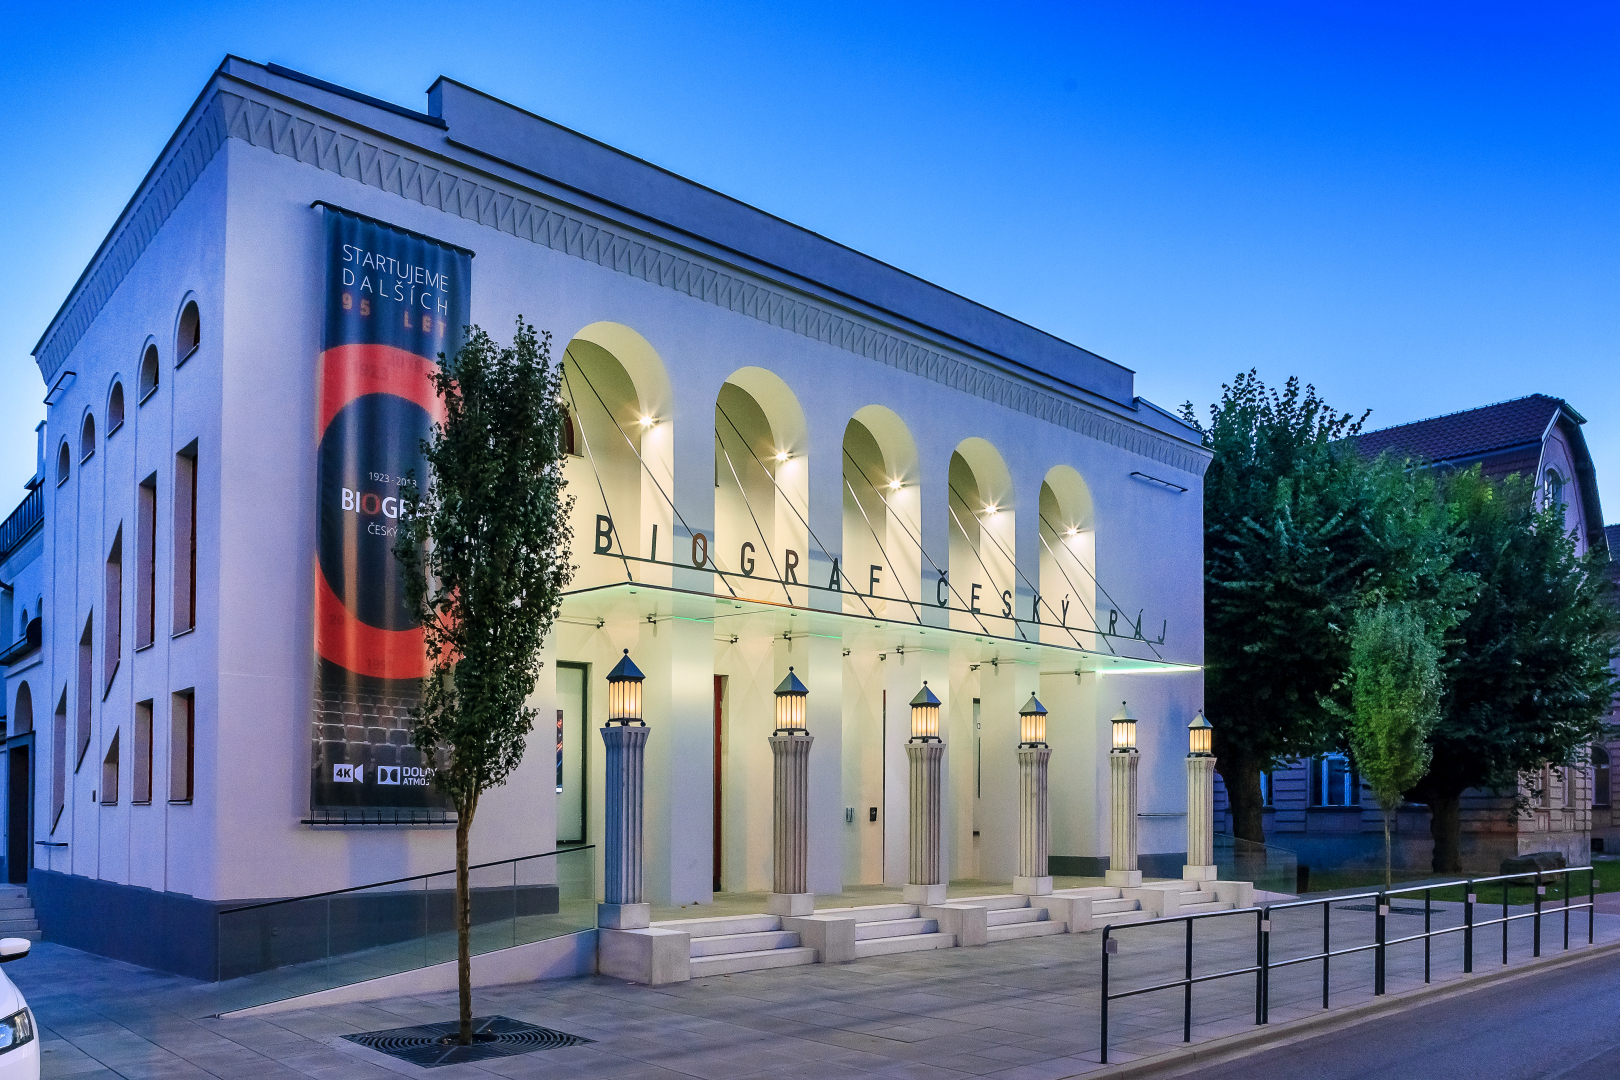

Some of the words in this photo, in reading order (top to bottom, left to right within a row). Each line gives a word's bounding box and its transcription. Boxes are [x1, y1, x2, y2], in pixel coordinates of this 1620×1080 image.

[342, 244, 448, 293] STARTUJEME
[342, 267, 448, 316] DALŠÍCH
[342, 293, 371, 316] 95
[403, 310, 446, 338] LET
[368, 471, 390, 483] 1923
[396, 476, 417, 487] 2013
[367, 521, 398, 537] ČESKÝ
[595, 513, 883, 597] BIOGRAF
[936, 569, 1070, 627] ČESKÝ
[1108, 608, 1167, 644] RÁJ
[335, 768, 351, 778] 4K
[402, 777, 430, 786] ATMOS
